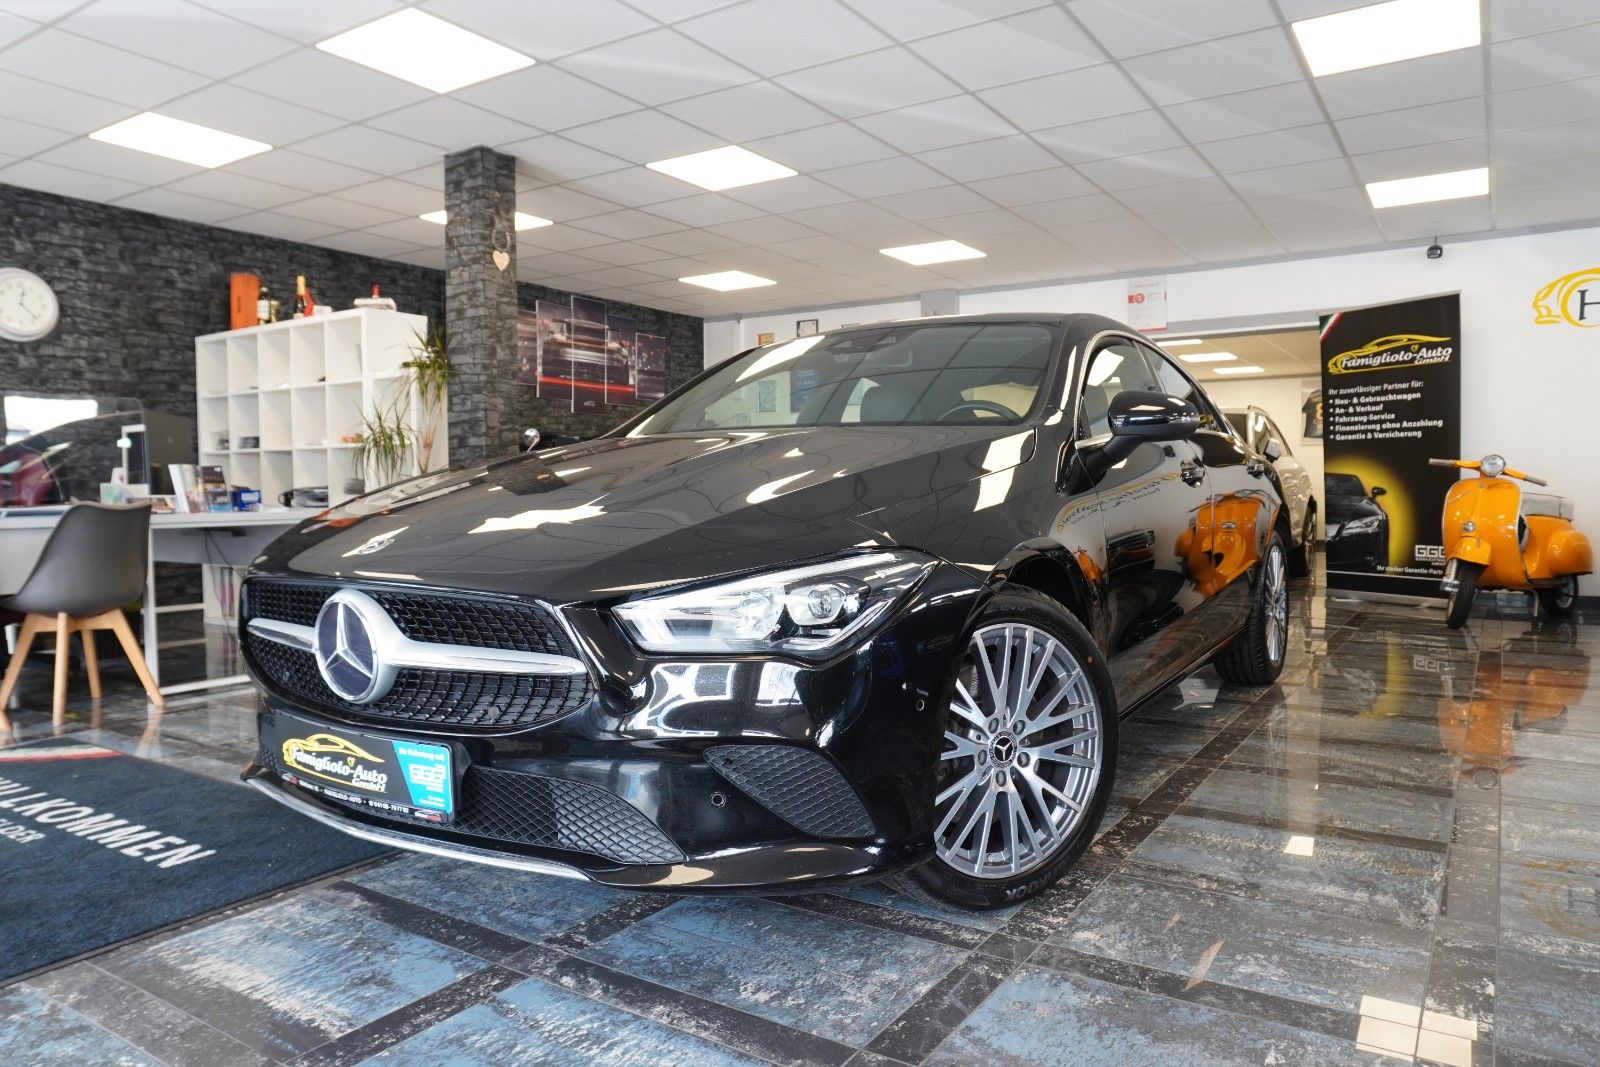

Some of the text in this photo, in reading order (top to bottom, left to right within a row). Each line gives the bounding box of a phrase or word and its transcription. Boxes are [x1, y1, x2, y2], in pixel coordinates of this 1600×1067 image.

[1341, 346, 1452, 367] Famigliolo-Auto
[1339, 385, 1382, 394] zuverlässiger
[1383, 382, 1410, 390] Partner
[1359, 392, 1421, 403] Gebrauchtwagen
[1355, 403, 1383, 412] Verkauf
[1334, 412, 1396, 423] Fahrzeug-Service
[1334, 419, 1443, 432] Finanzierung ohne Anzahlung
[1335, 432, 1366, 441] Garantie
[1373, 430, 1422, 439] Versicherung
[292, 746, 388, 784] Famigliolo-Auto
